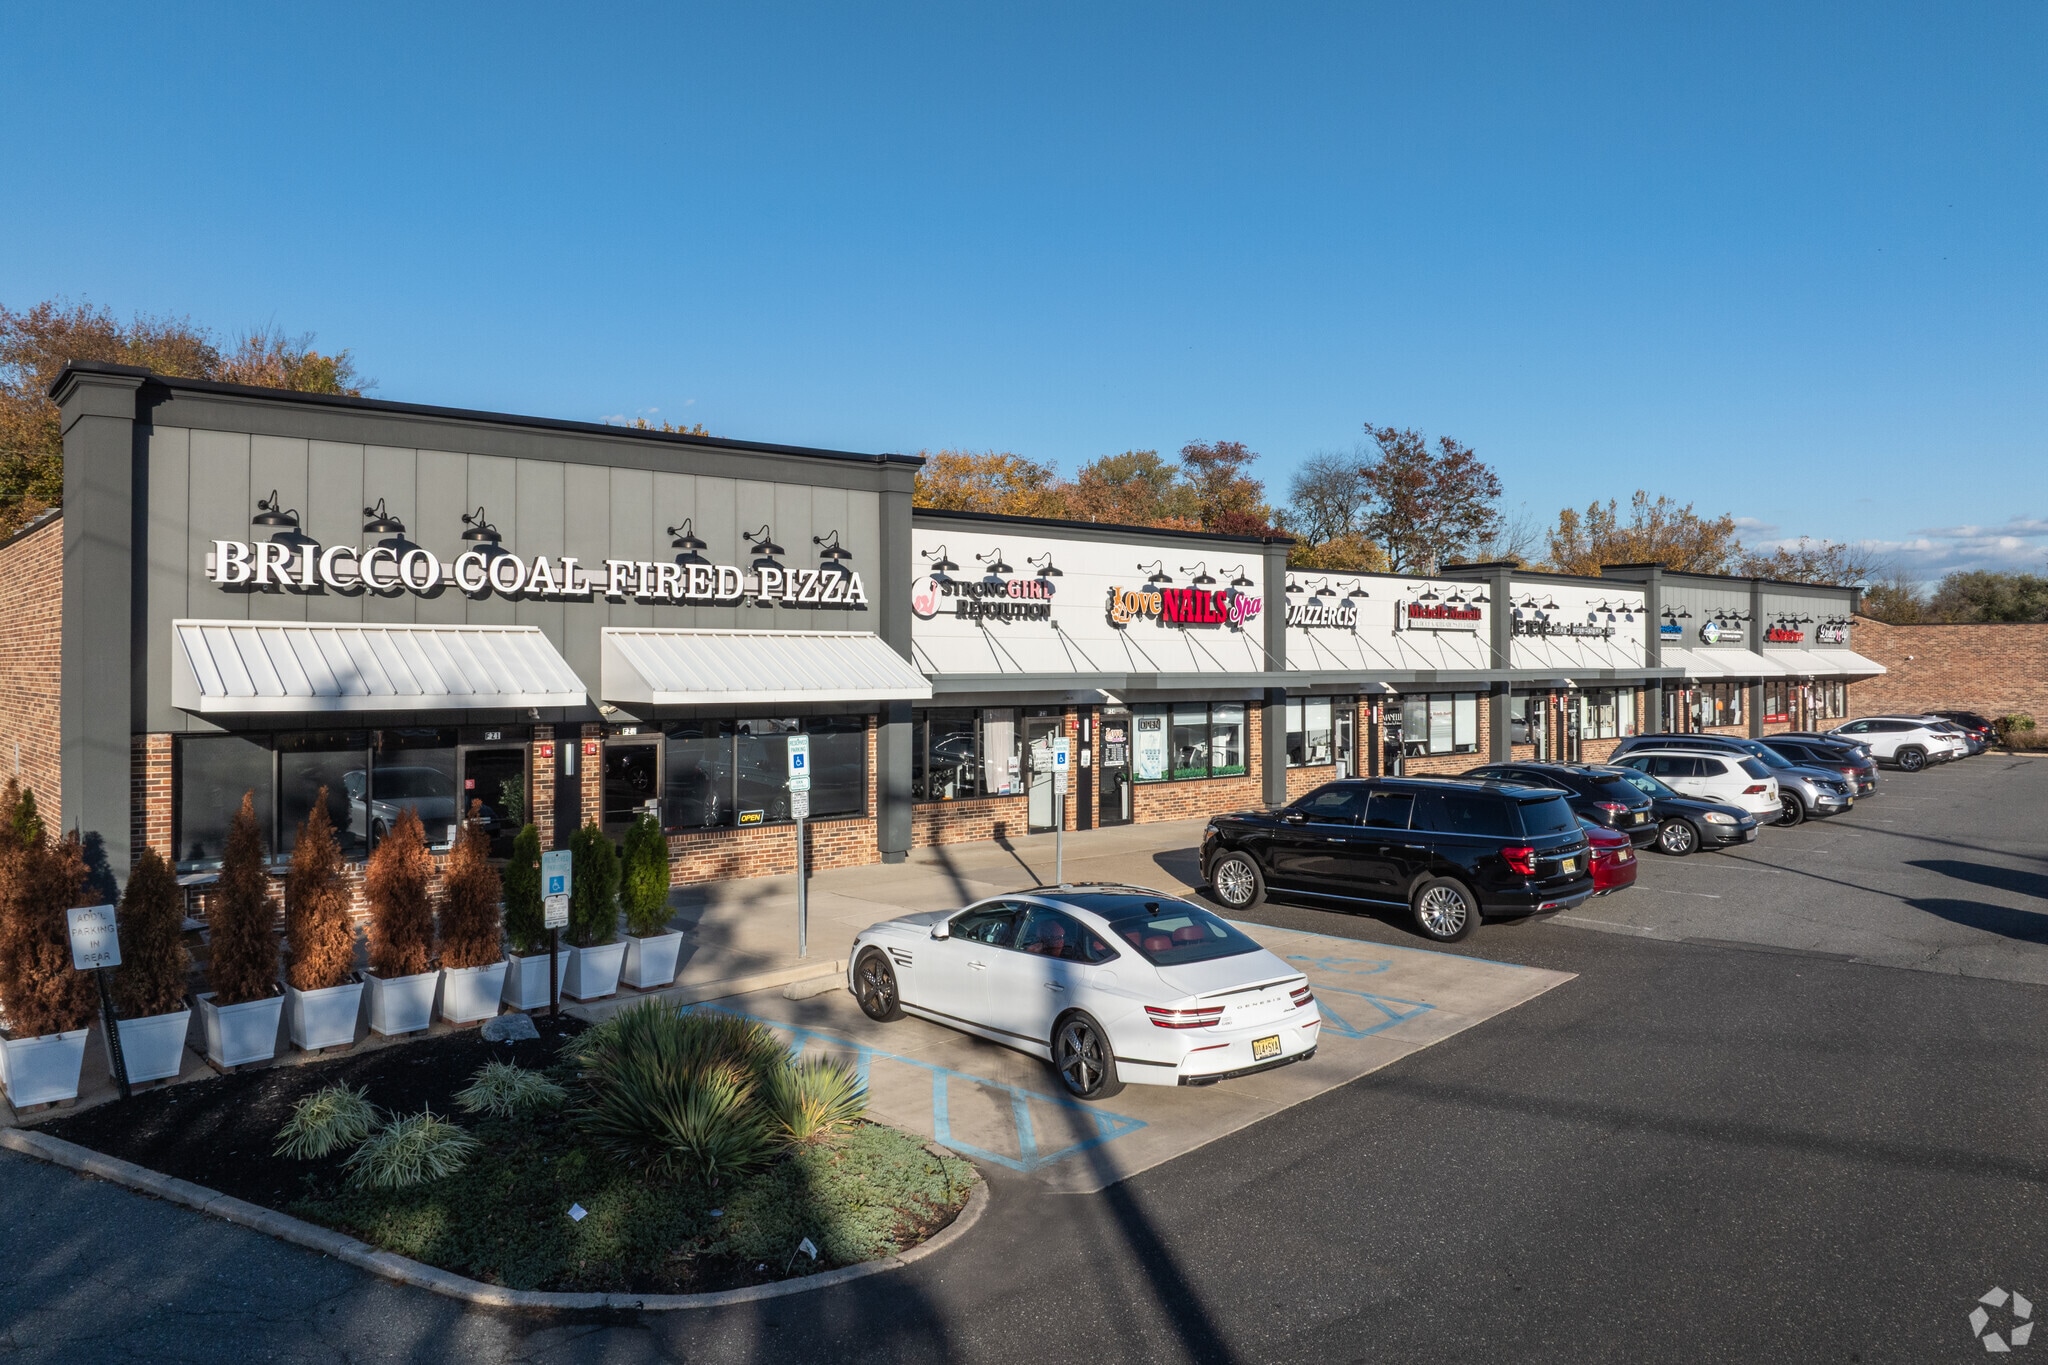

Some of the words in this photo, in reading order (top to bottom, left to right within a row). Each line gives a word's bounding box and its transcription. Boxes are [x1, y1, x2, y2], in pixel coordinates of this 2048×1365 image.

[211, 540, 440, 589] BRICCO
[454, 551, 590, 594] COAL
[605, 559, 744, 600] FIRED
[758, 567, 868, 604] PIZZA
[957, 600, 1051, 620] REVOLUTION
[1110, 586, 1162, 622] Love
[1162, 587, 1228, 623] NAILS
[1229, 592, 1263, 627] Spa
[1289, 605, 1362, 626] JAZZERCISE
[1141, 721, 1160, 729] OPEN
[741, 814, 760, 822] OPEN
[77, 912, 107, 922] ADD'L
[71, 924, 115, 937] PARKING
[90, 940, 100, 949] IN
[83, 952, 111, 963] REAR
